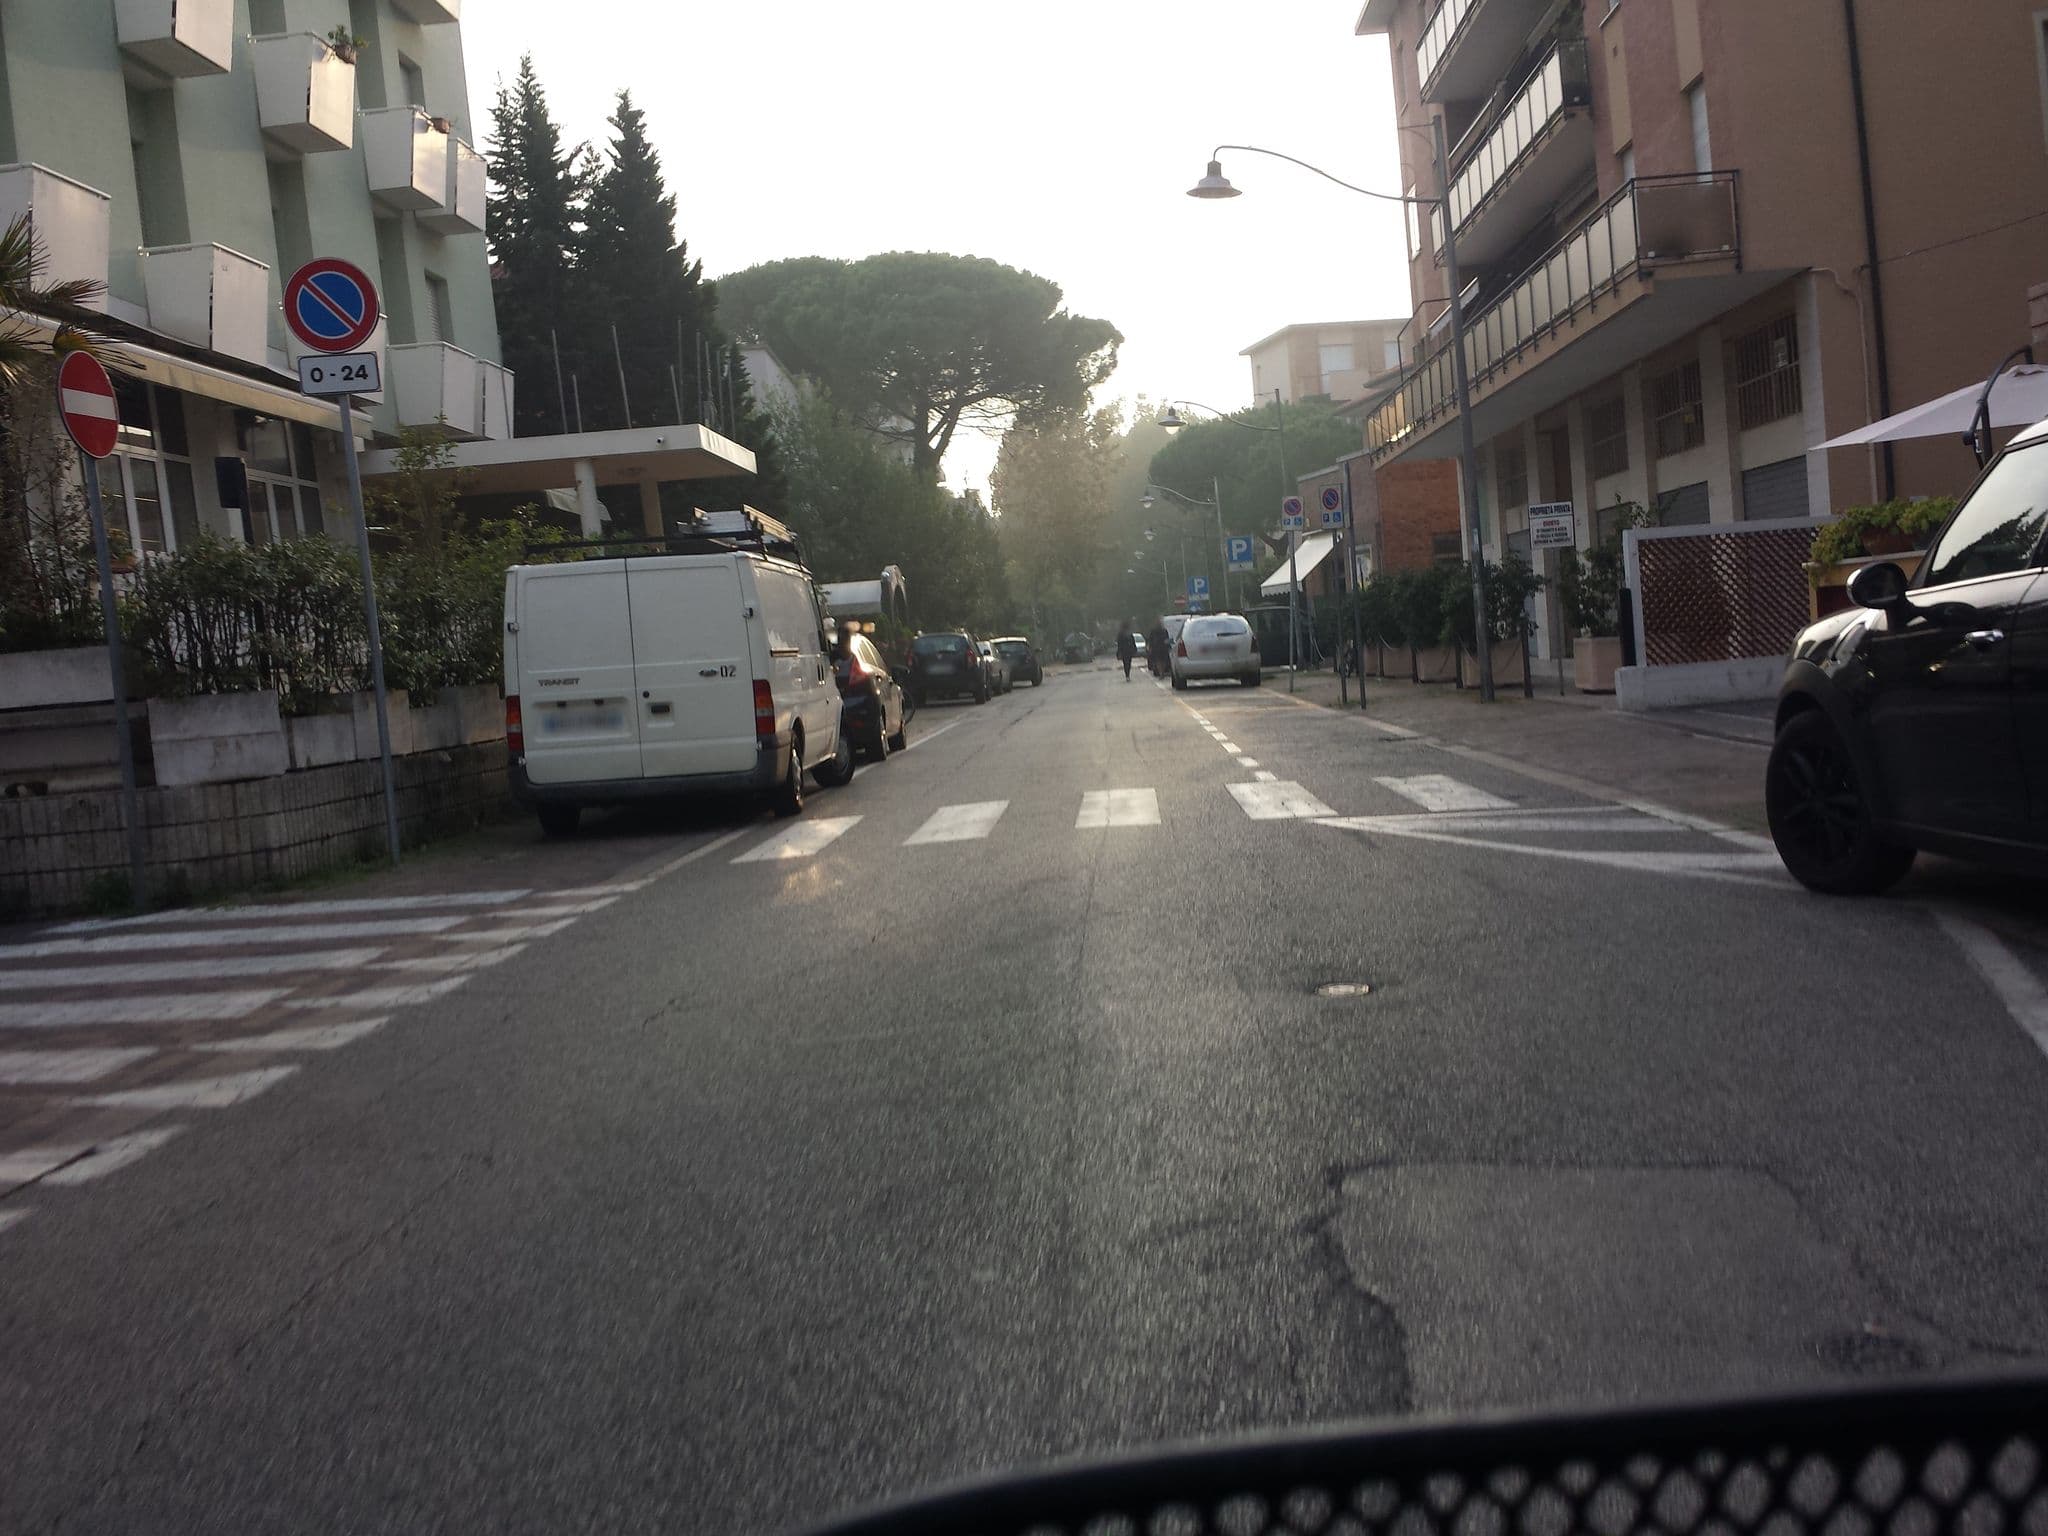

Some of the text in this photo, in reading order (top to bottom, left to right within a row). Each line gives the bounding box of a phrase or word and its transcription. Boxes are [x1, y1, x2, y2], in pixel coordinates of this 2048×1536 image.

[1231, 539, 1247, 560] P
[1194, 578, 1205, 593] P
[537, 677, 580, 688] TRANSIT
